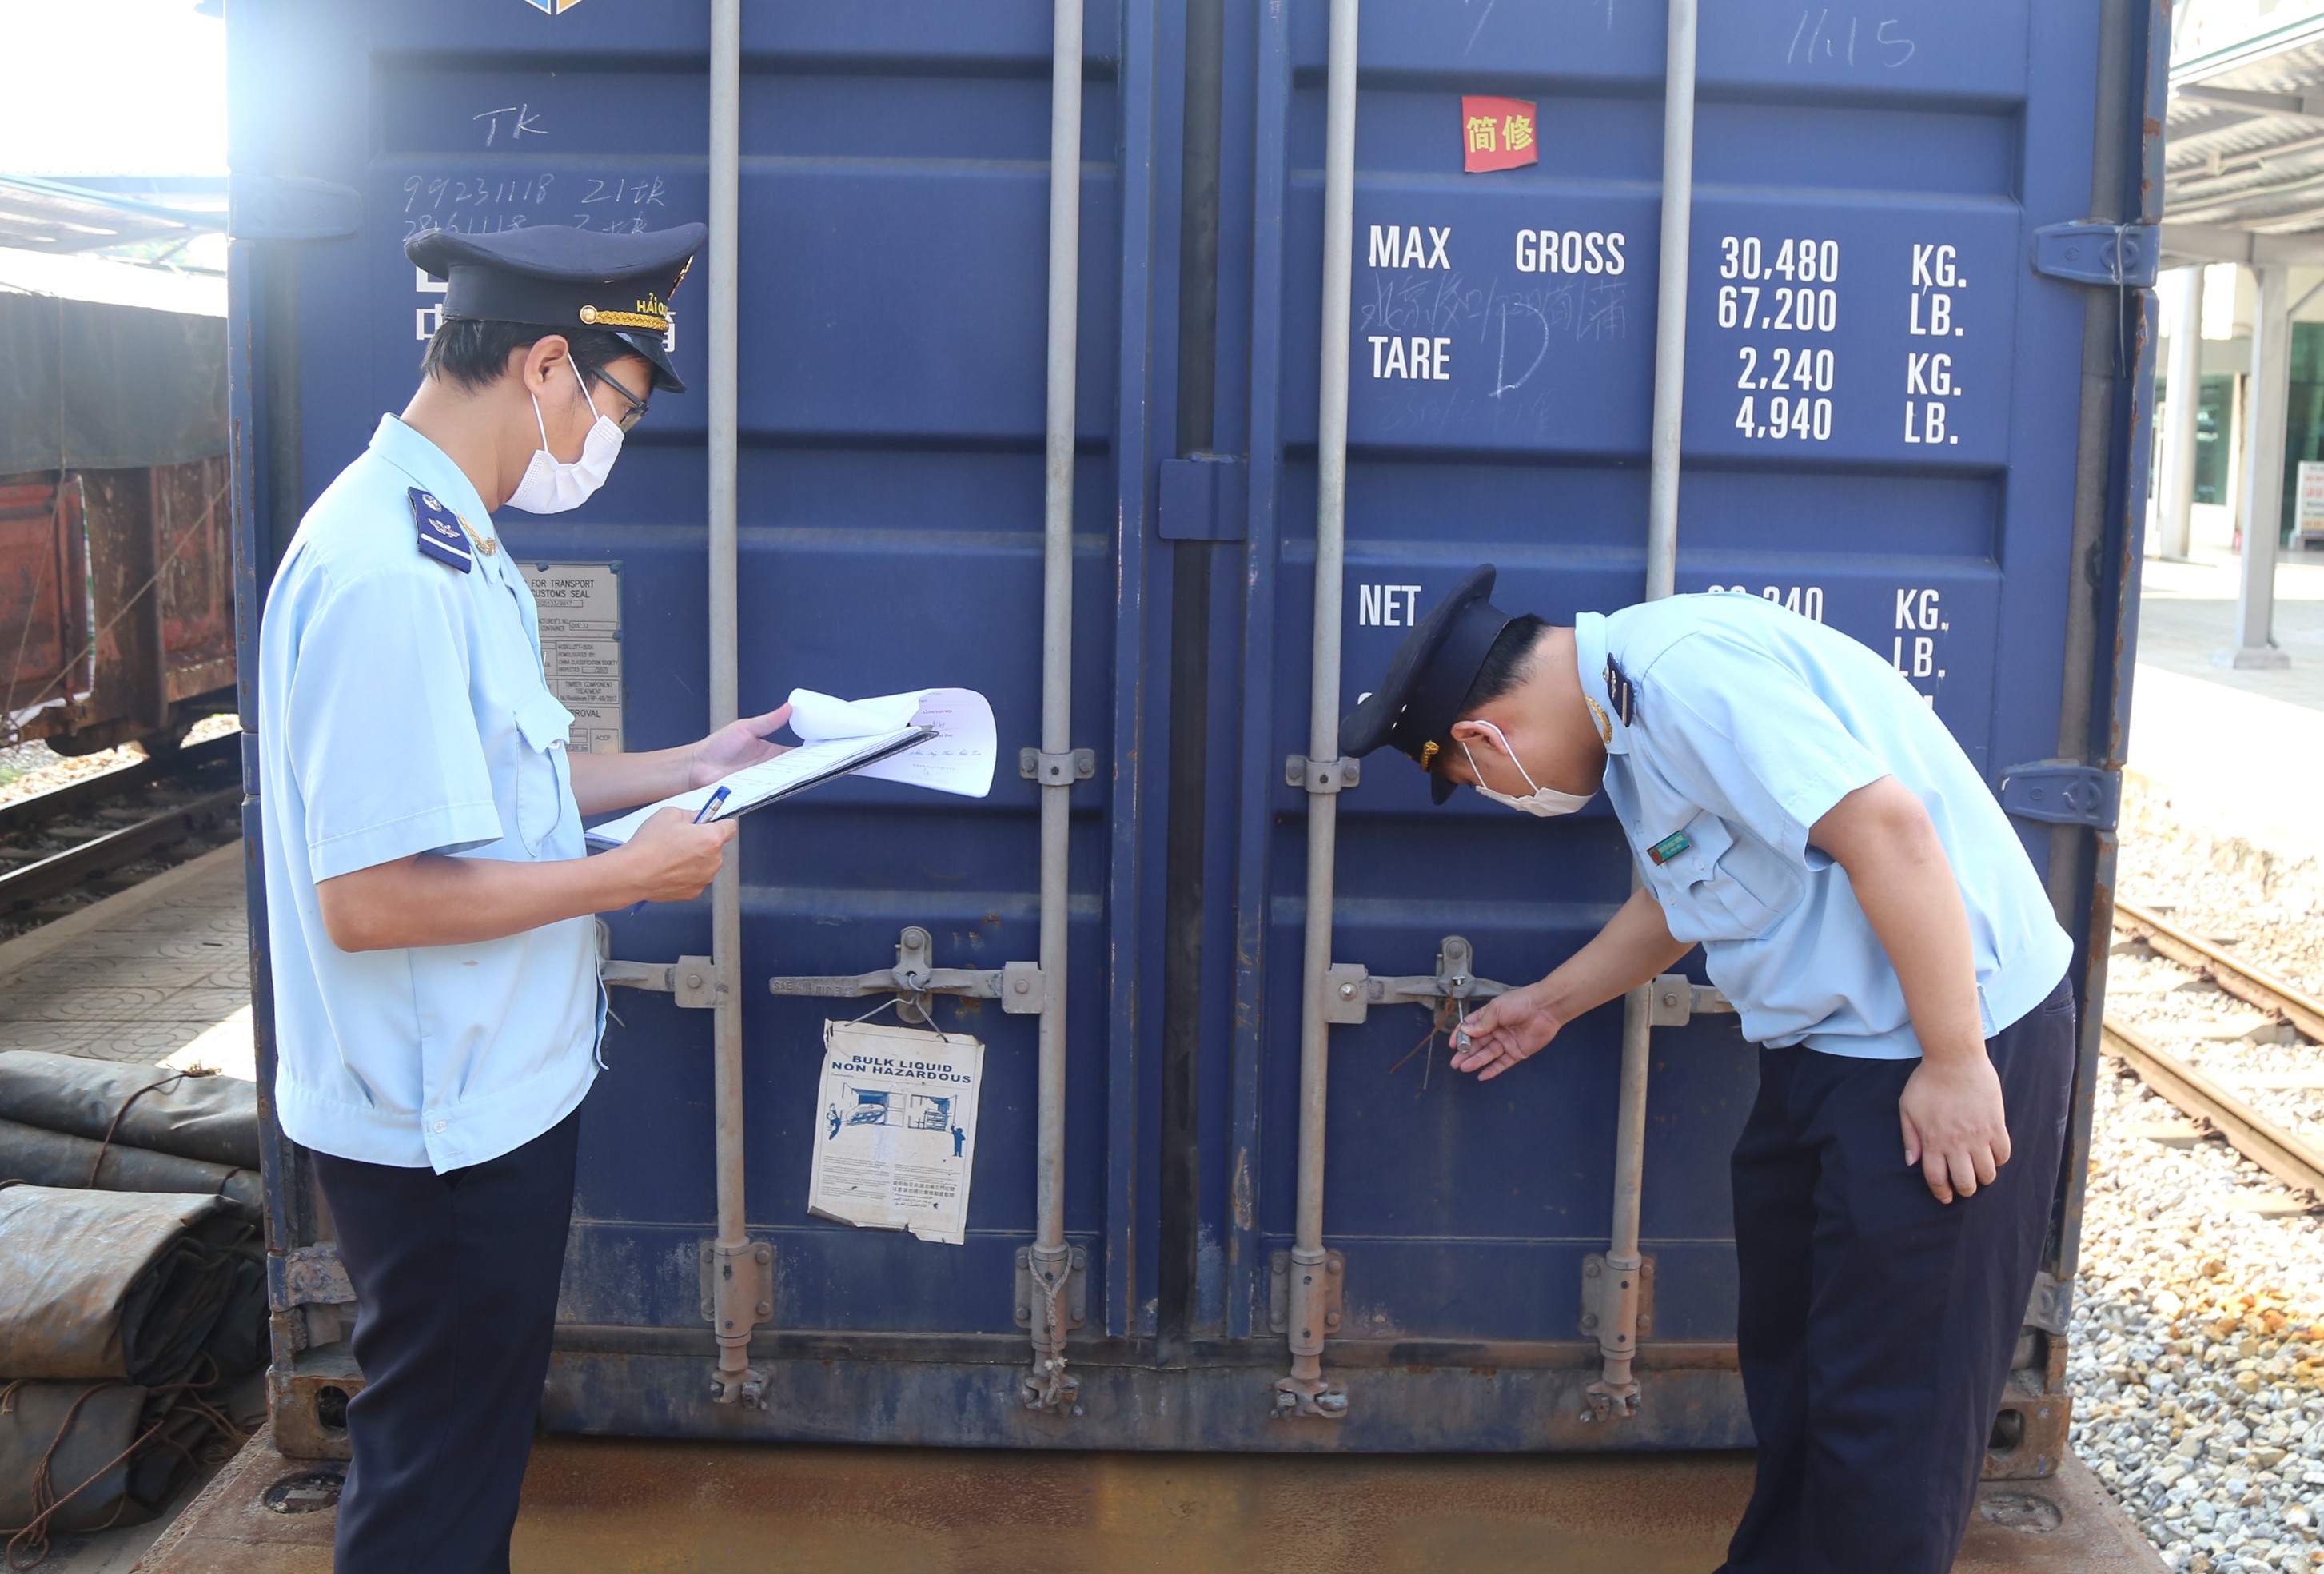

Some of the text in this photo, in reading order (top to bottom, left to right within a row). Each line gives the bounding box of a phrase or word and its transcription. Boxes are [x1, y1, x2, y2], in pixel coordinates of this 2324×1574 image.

[473, 103, 548, 147] TK
[1466, 114, 1533, 153] 简修
[1368, 225, 1967, 288] MAX GROSS 30,480 KG.
[1718, 285, 1964, 337] 67,200 LB.
[1367, 336, 1962, 396] TARE 2,240 KG.
[1735, 396, 1959, 445] 4,940 LB.
[531, 579, 595, 588] FOR TRANSPORT
[531, 589, 591, 599] CUSTOMS SEAL
[1359, 584, 1422, 627] NET
[1895, 588, 1950, 631] KG.
[1893, 636, 1947, 679] LB.
[831, 1062, 972, 1083] NON HAZARDOUS
[852, 1055, 953, 1073] BULK LIQUID
